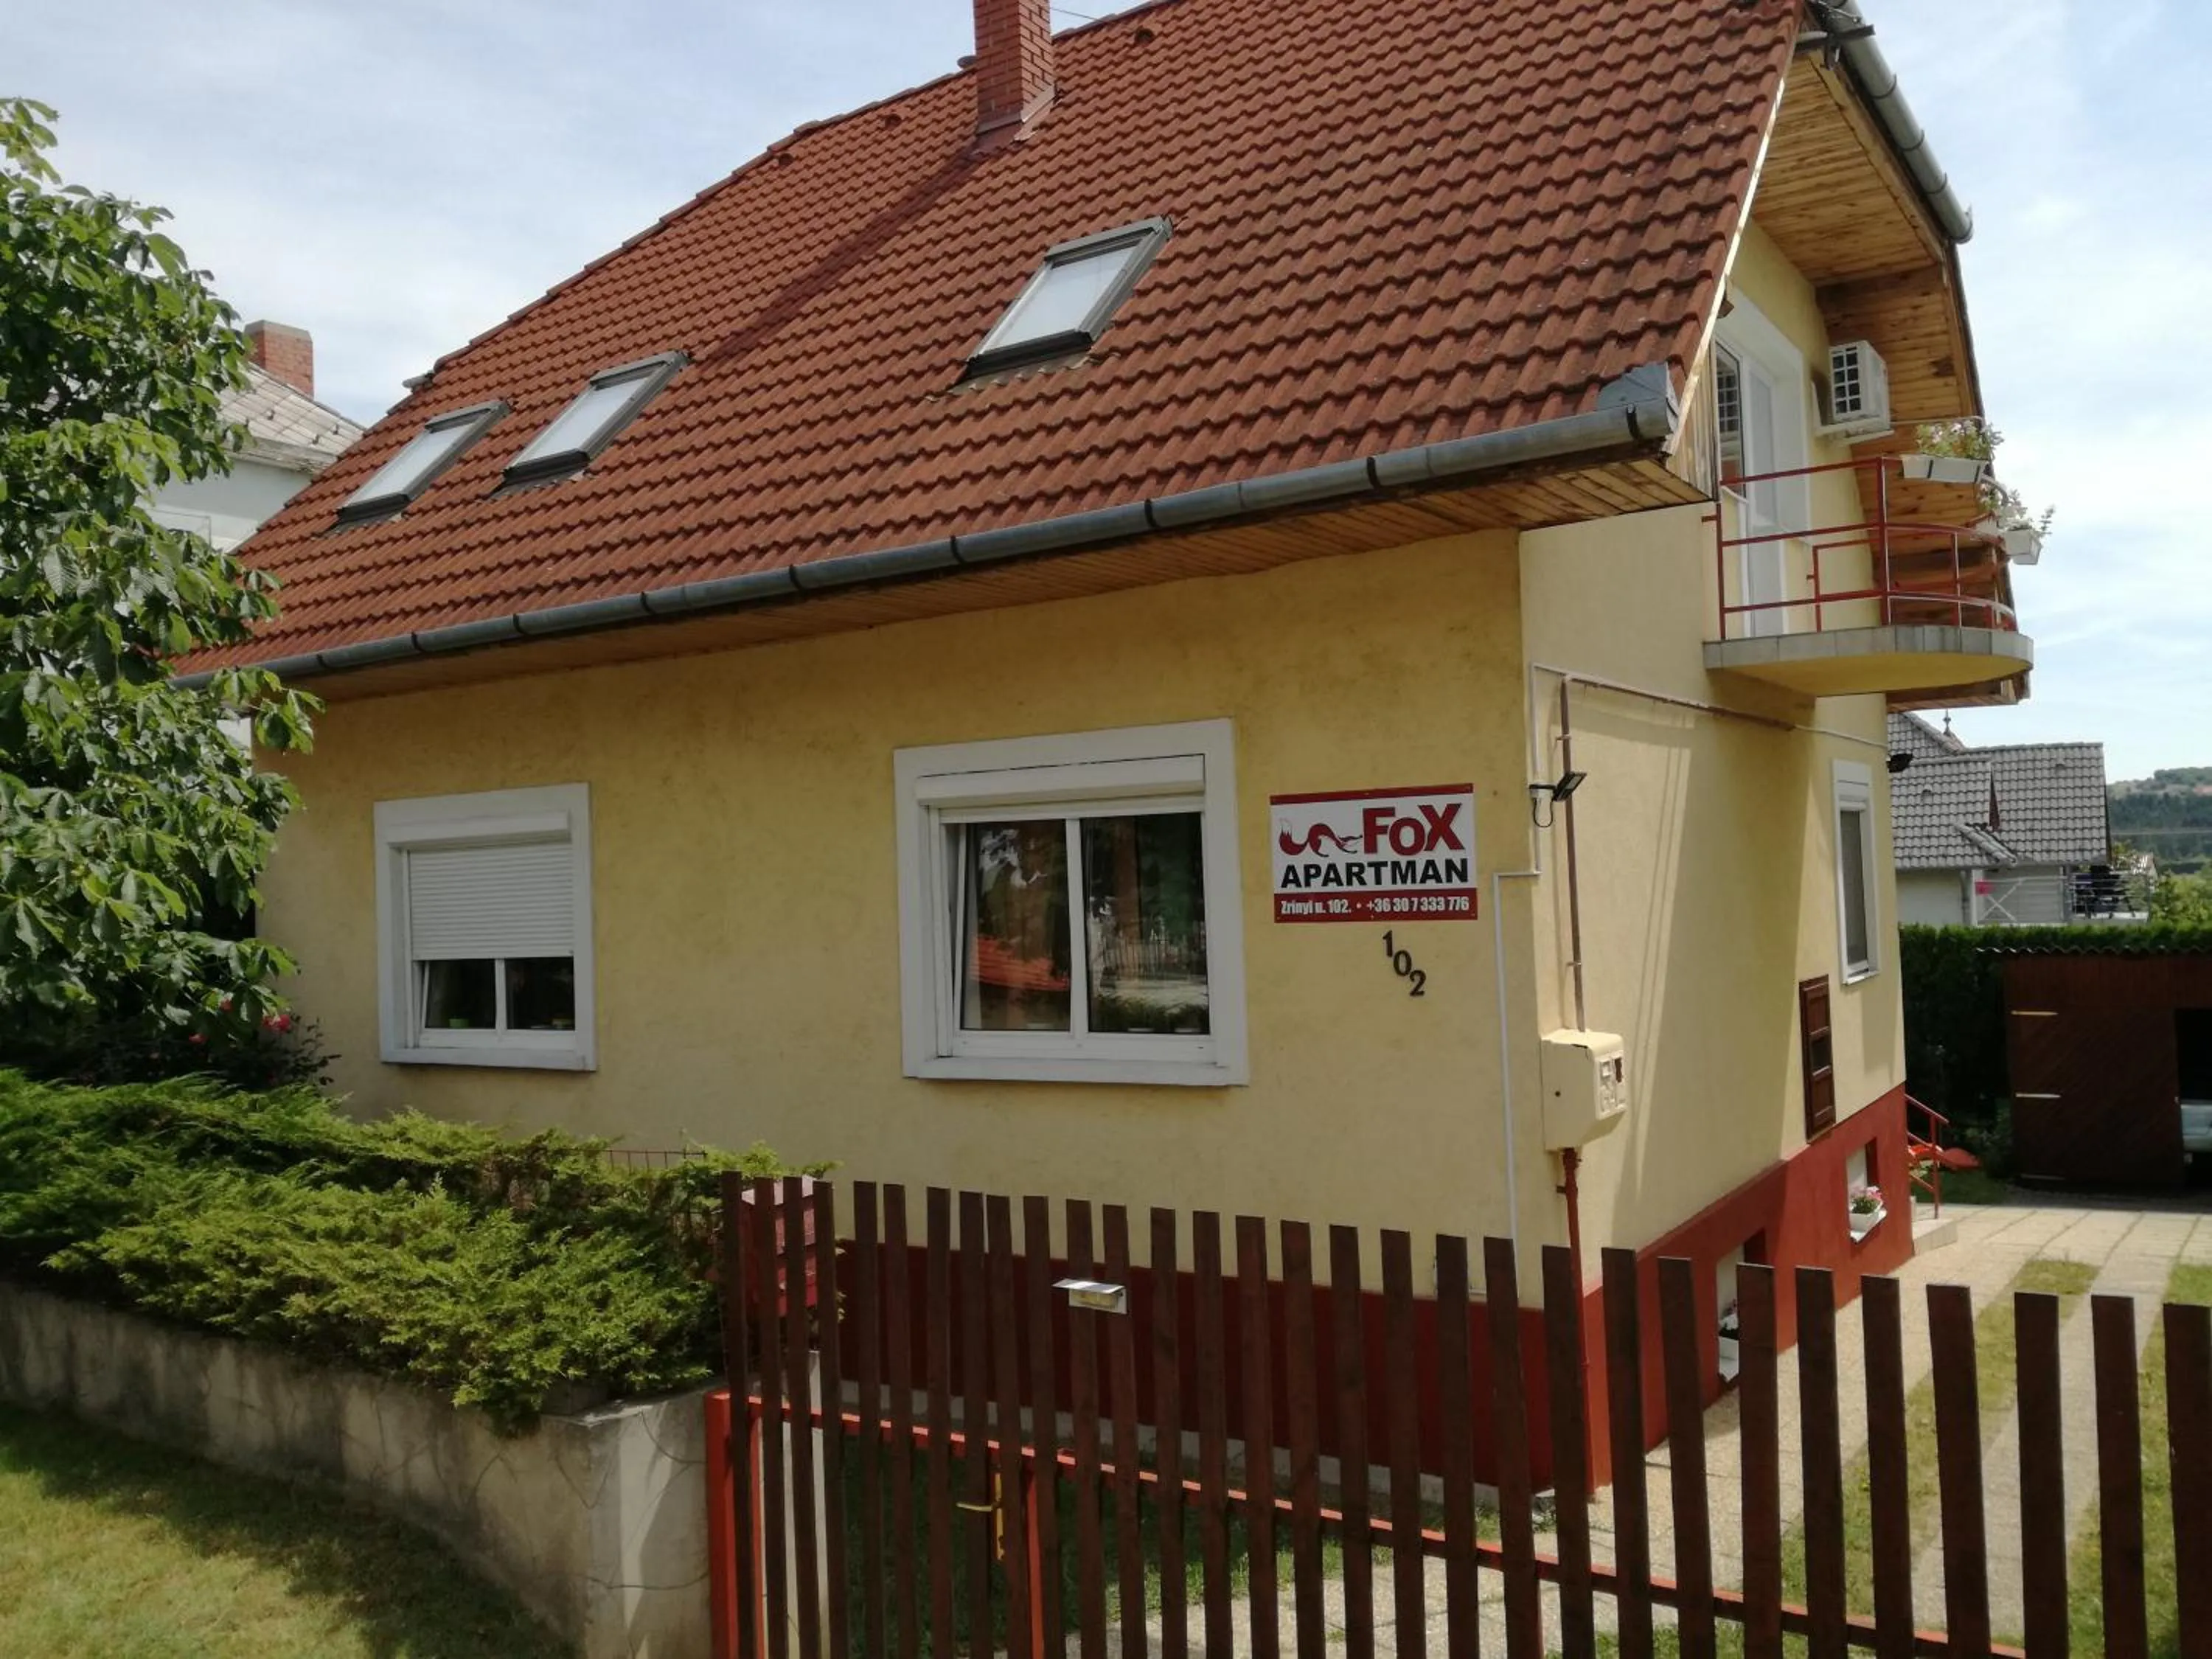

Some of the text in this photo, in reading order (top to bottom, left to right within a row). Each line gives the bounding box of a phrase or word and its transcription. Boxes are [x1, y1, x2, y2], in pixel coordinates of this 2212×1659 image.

[1281, 858, 1468, 888] APARTMAN
[1327, 899, 1352, 914] 102.
[1366, 897, 1391, 912] +36
[1393, 897, 1409, 912] 30
[1411, 897, 1419, 911] 7
[1420, 897, 1445, 911] 333
[1447, 896, 1470, 911] 776
[1382, 930, 1427, 996] 102
